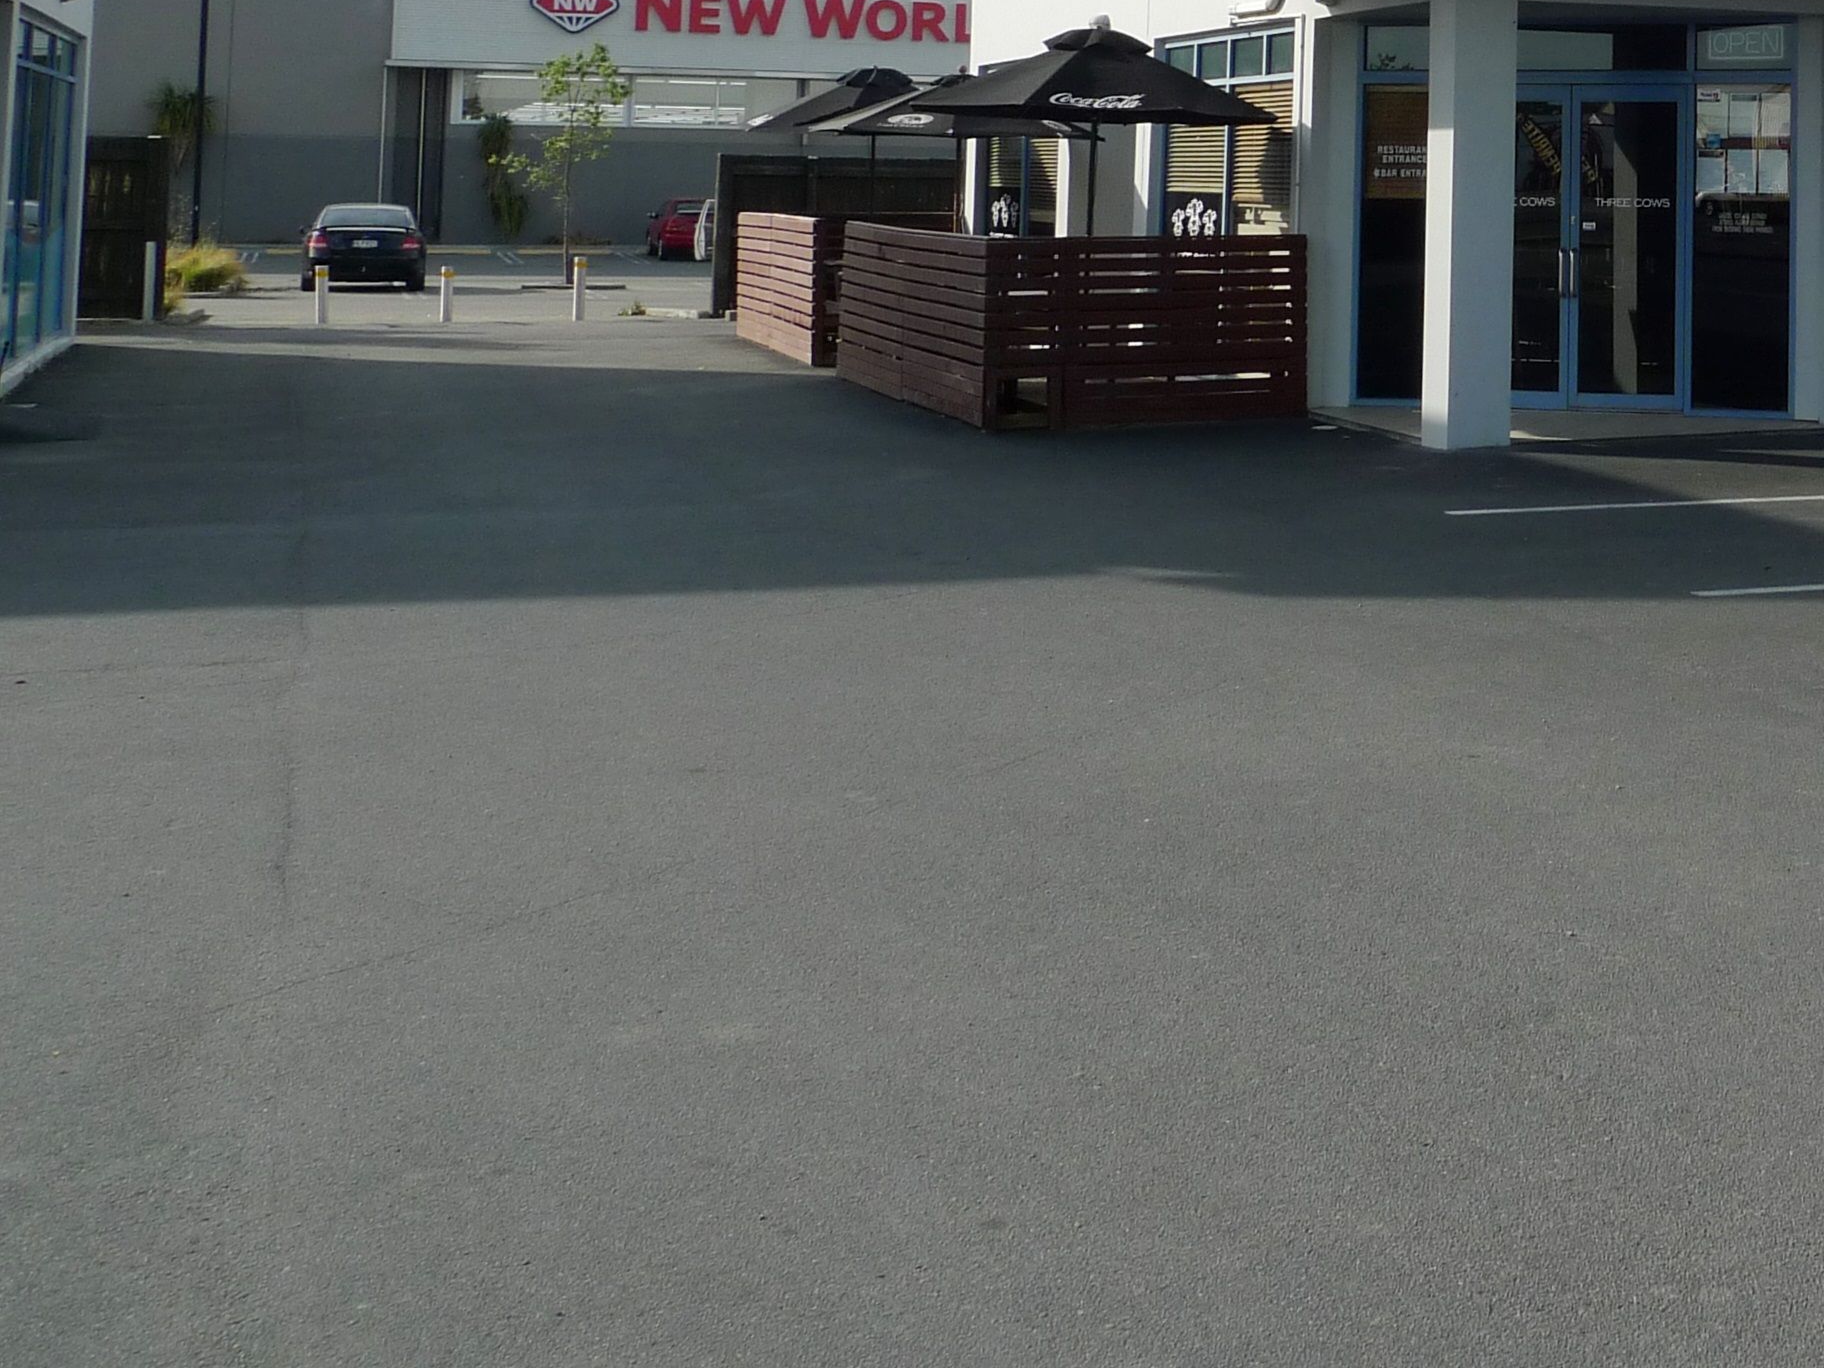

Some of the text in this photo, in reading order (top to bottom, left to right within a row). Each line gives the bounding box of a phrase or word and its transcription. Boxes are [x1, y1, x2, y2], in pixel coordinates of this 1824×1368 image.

[1712, 30, 1779, 54] OPEN
[1377, 145, 1427, 154] RESTAURAN
[1519, 196, 1556, 207] COWS
[1594, 197, 1670, 208] THREE COWS
